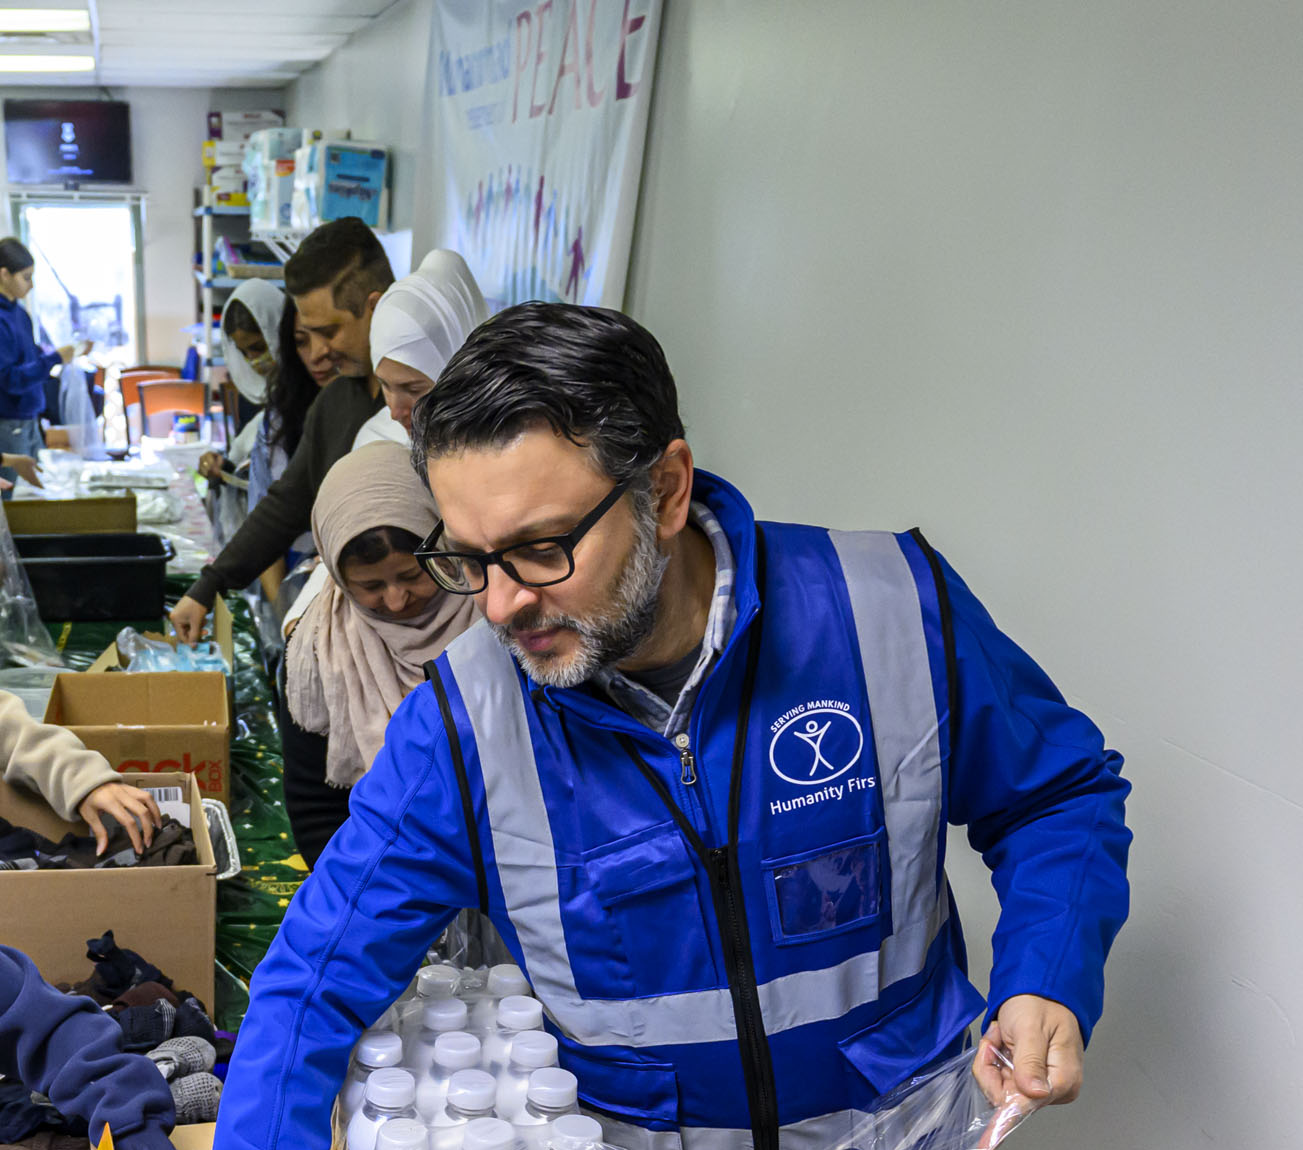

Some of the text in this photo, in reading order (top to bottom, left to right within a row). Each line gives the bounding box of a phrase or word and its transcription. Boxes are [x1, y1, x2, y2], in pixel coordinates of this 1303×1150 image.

[510, 0, 646, 124] PEACE
[770, 699, 851, 734] SERVING MANKIND
[207, 760, 223, 793] BOX
[769, 776, 877, 816] Humanity Firs
